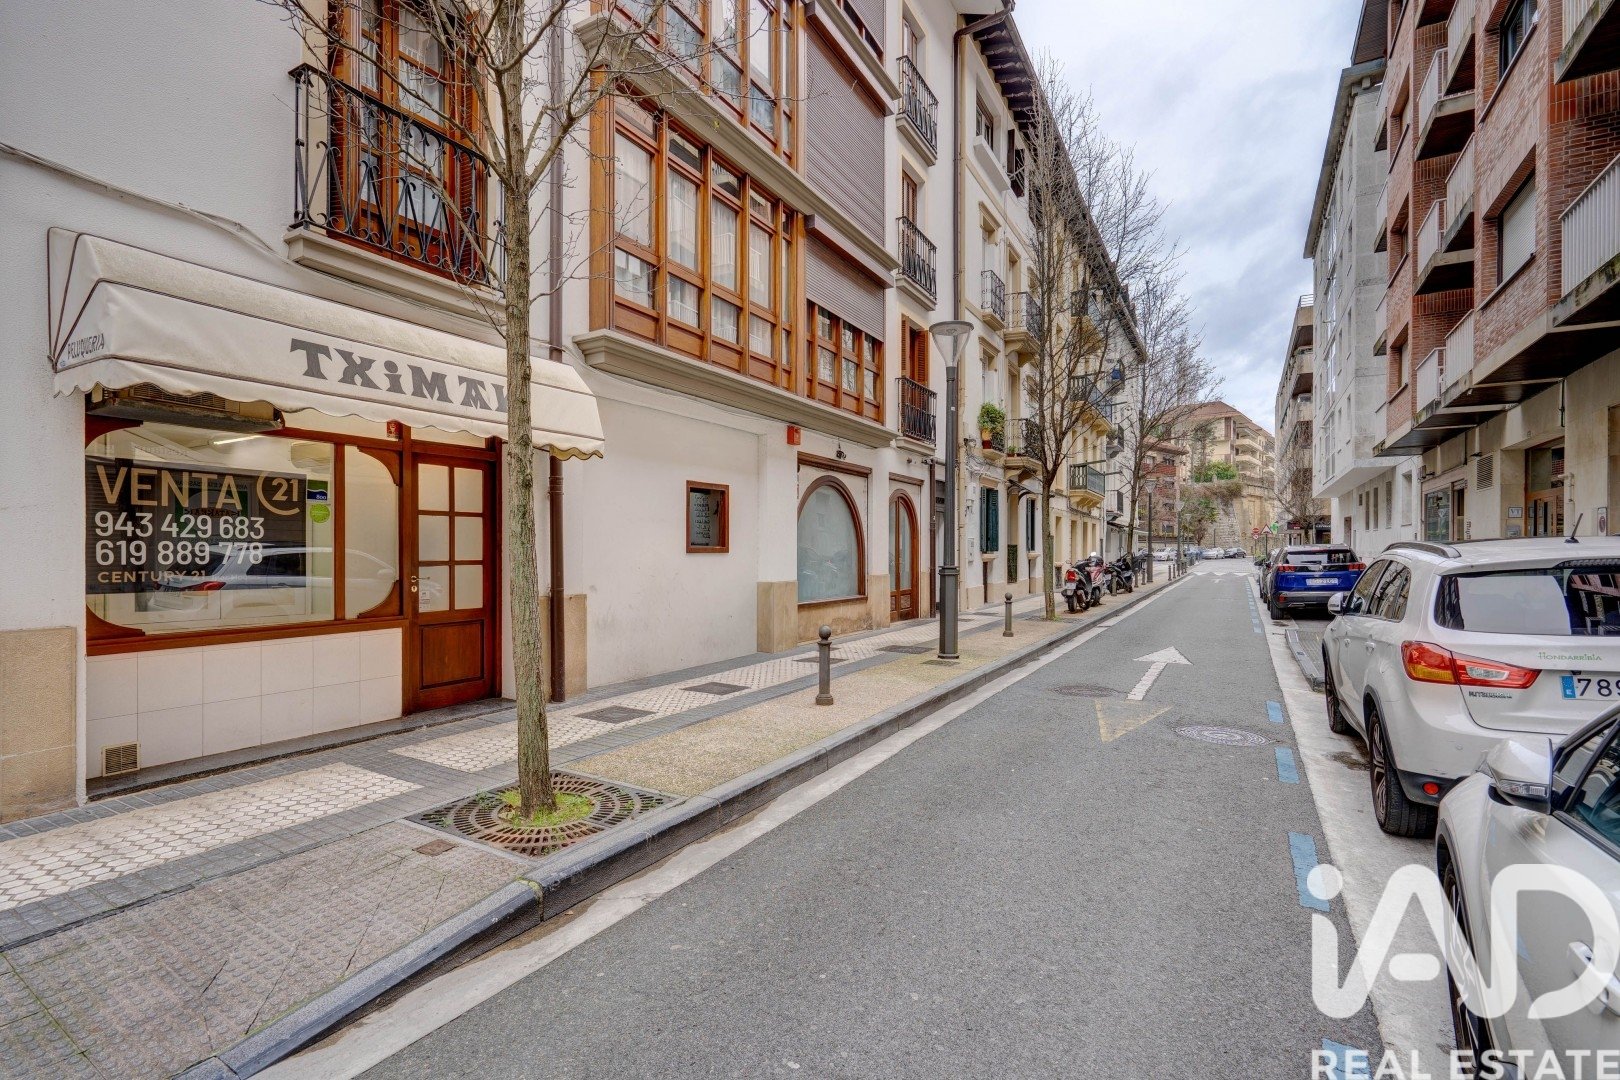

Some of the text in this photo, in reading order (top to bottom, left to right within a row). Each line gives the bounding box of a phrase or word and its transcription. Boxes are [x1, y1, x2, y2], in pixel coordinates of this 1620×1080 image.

[96, 465, 243, 510] VENTA
[94, 511, 265, 540] 943 429 683
[95, 540, 263, 566] 619 889 778
[97, 570, 187, 583] CENTURY
[191, 571, 207, 581] 21
